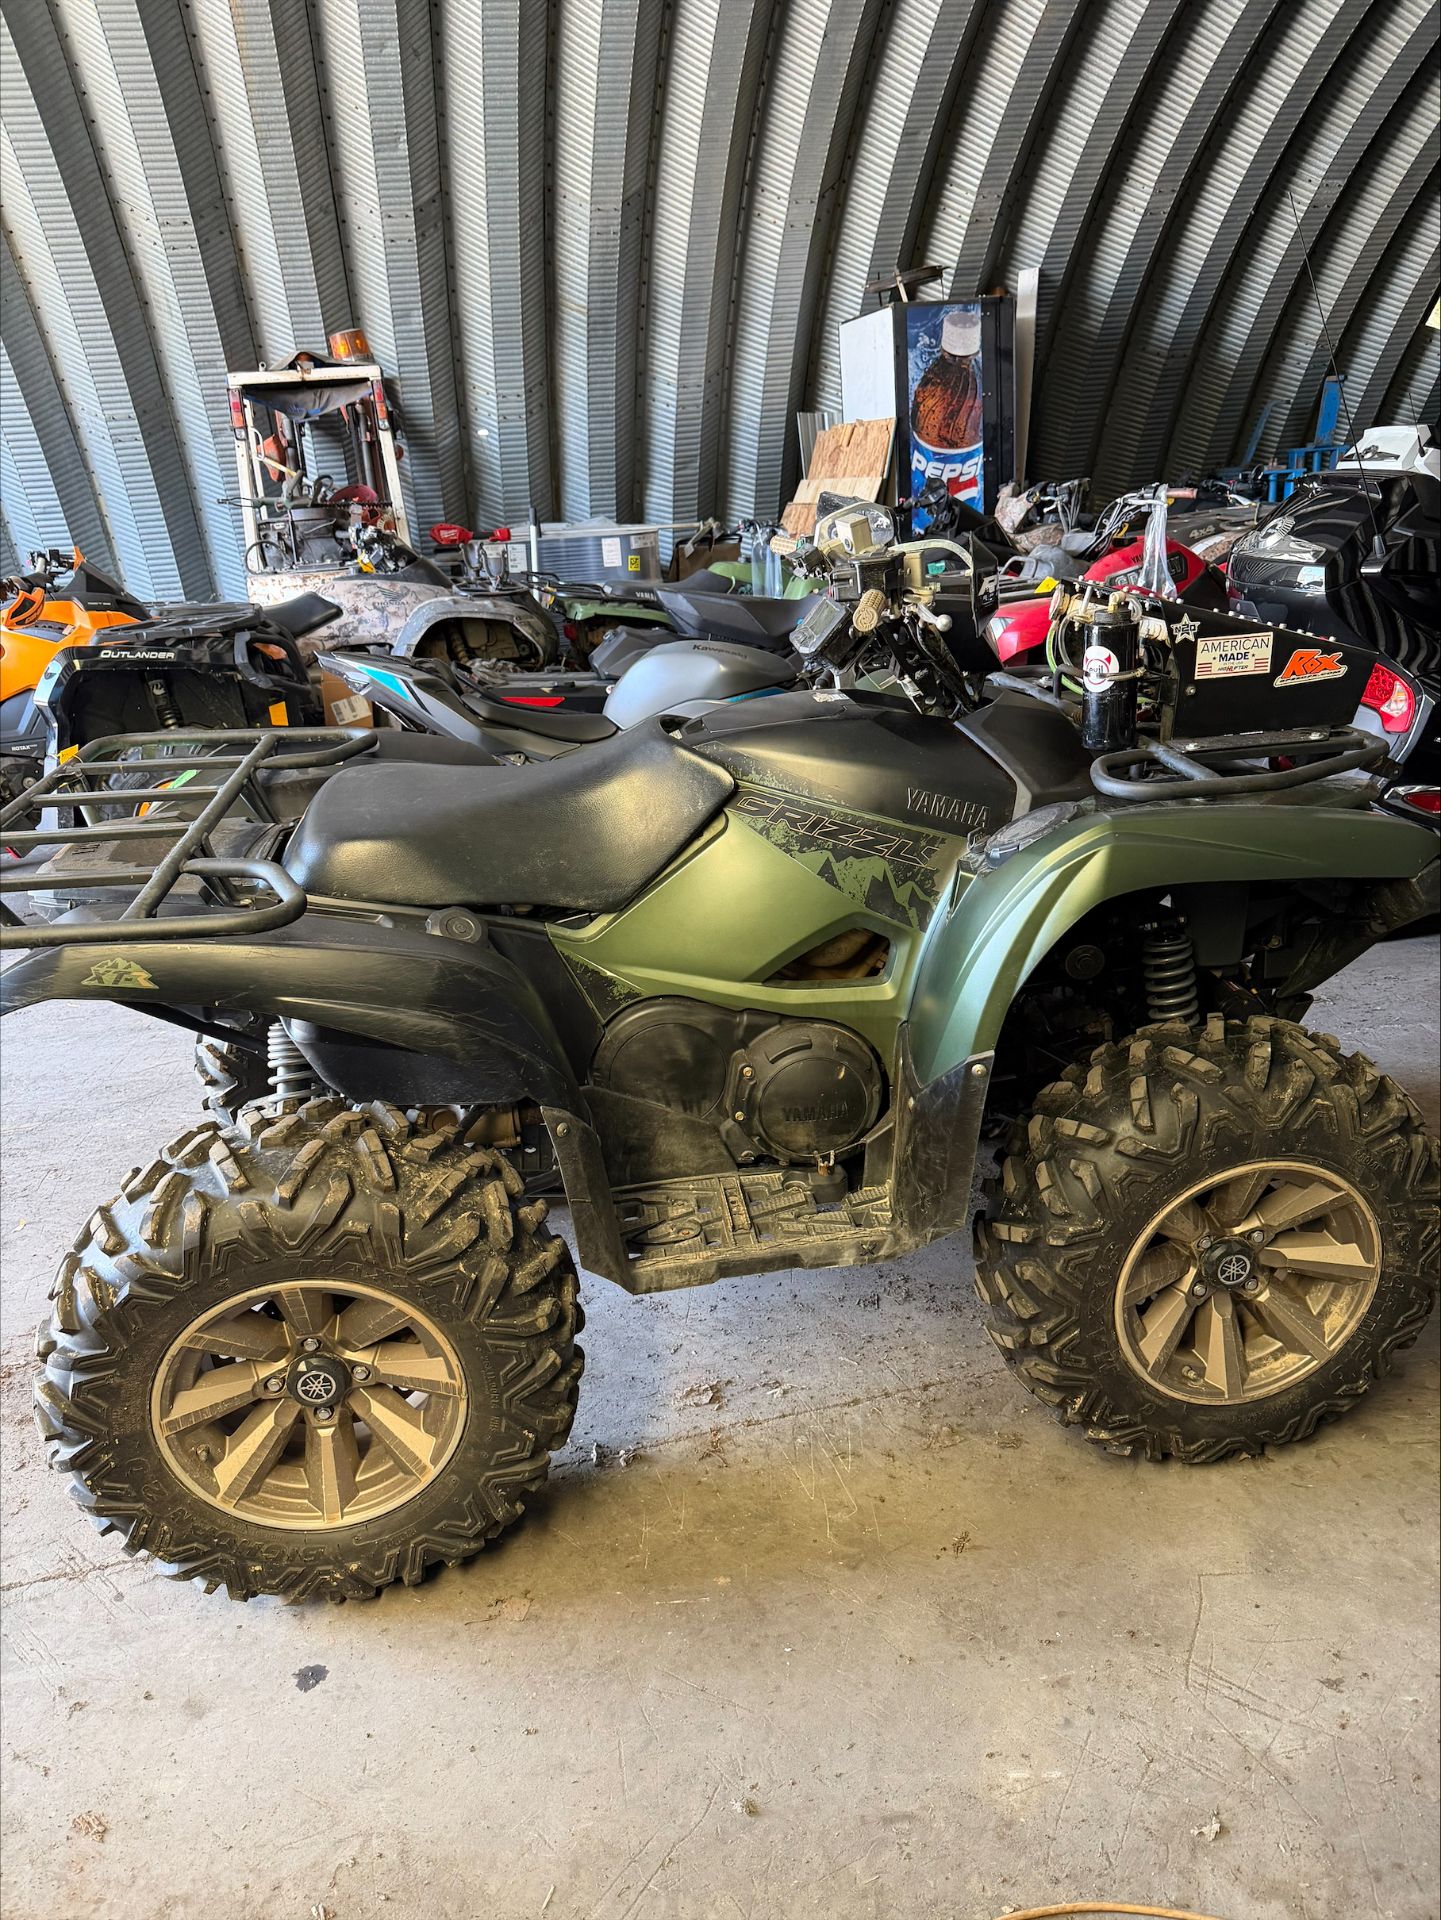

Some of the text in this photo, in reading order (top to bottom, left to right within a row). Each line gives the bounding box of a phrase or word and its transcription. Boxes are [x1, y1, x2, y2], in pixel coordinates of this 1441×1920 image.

[911, 450, 984, 485] PEPSI
[635, 591, 657, 601] YAMA
[1201, 637, 1270, 654] AMERICAN
[100, 650, 175, 660] OUTLANDER
[1219, 652, 1250, 662] MADE
[907, 787, 990, 828] YAMAHA
